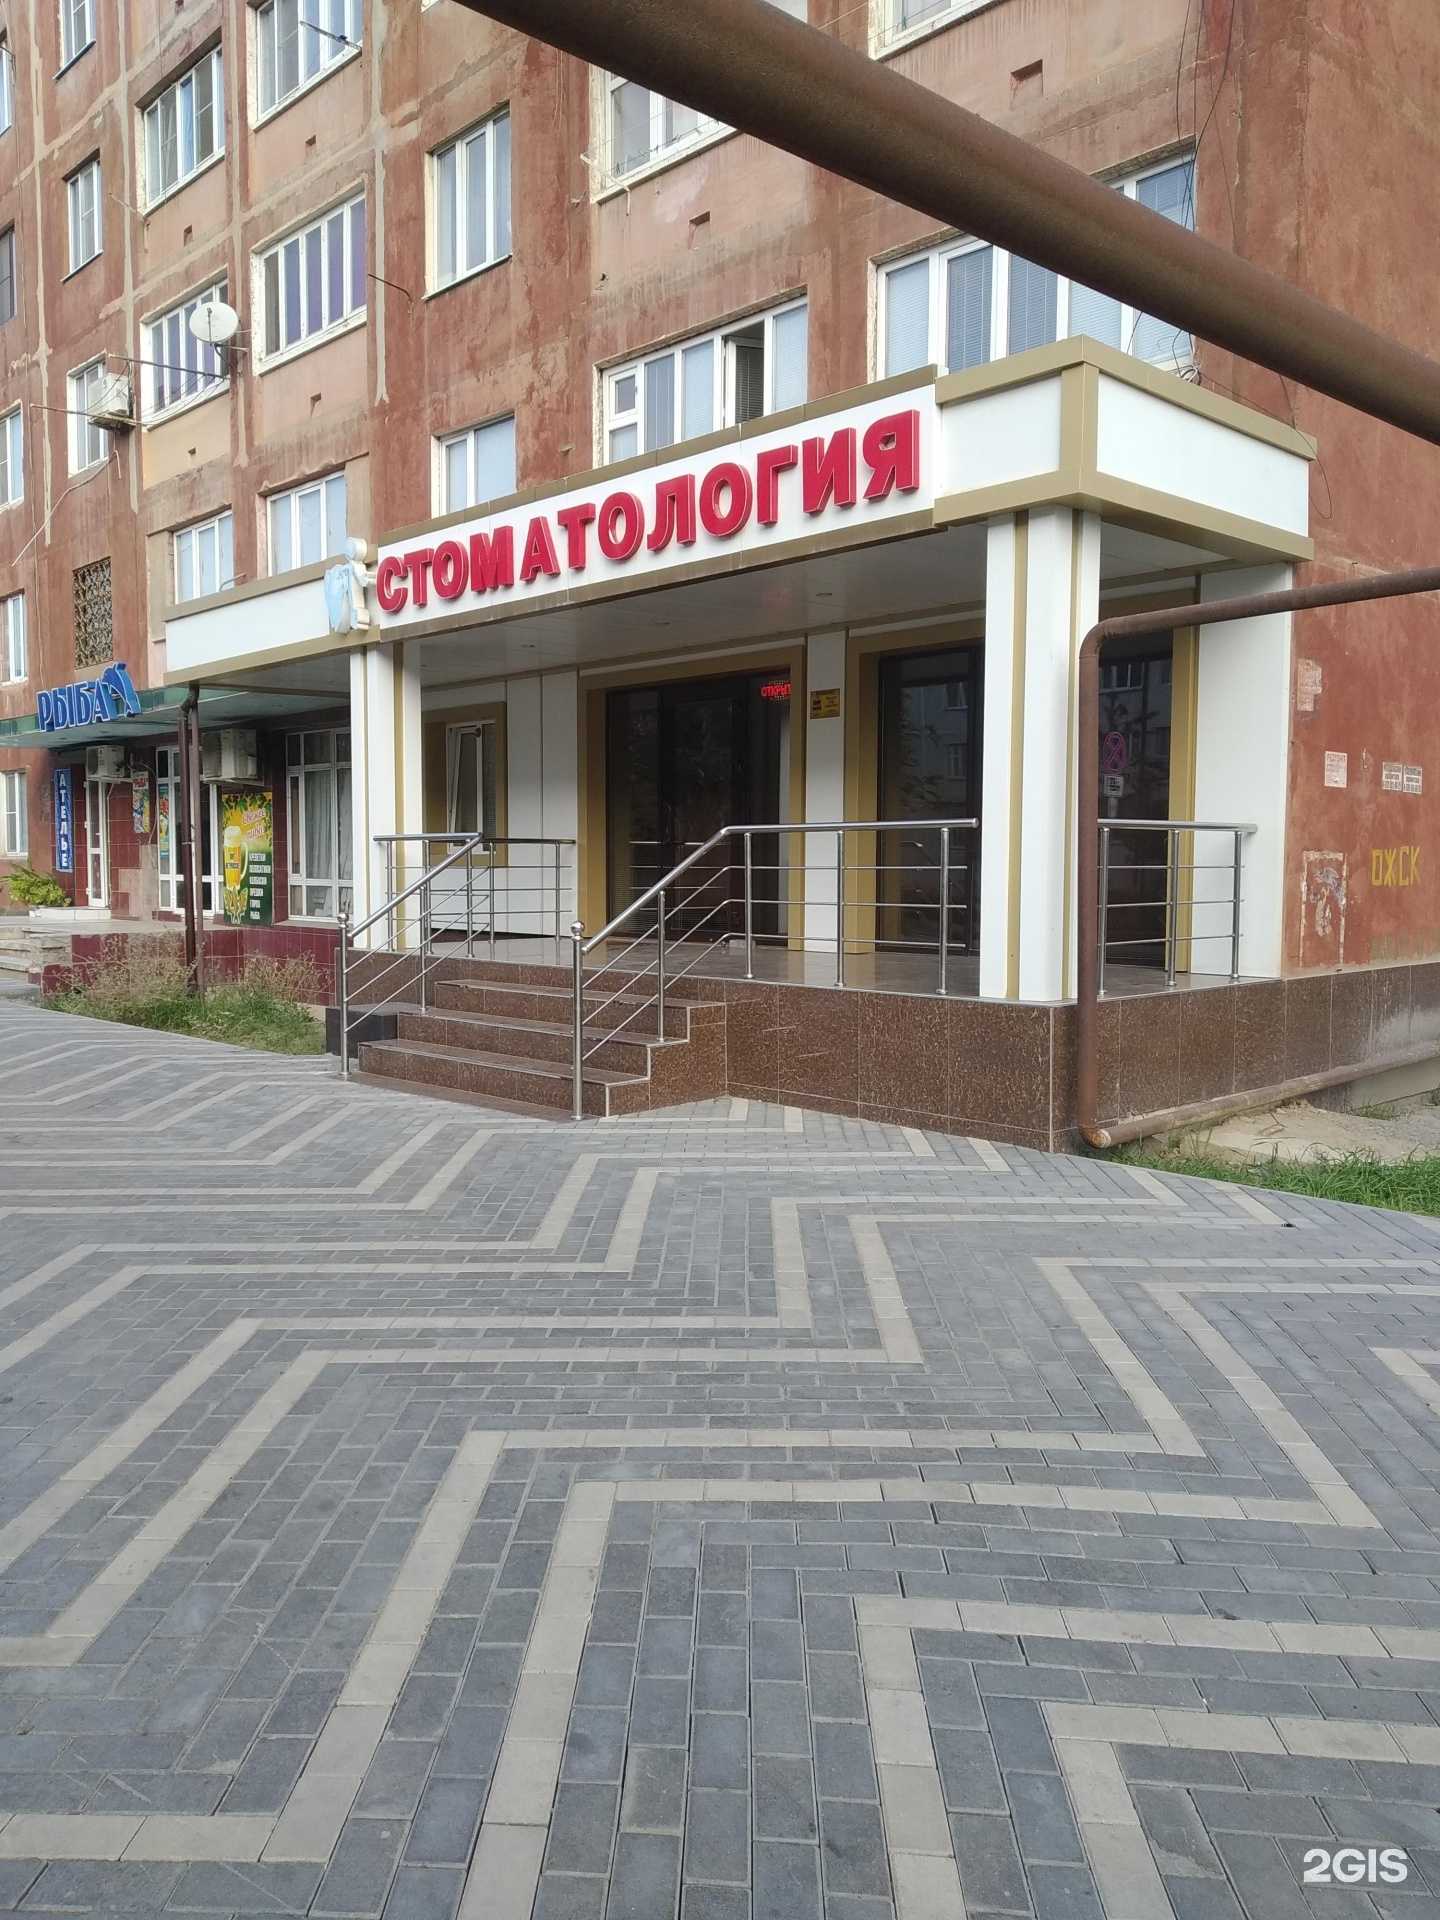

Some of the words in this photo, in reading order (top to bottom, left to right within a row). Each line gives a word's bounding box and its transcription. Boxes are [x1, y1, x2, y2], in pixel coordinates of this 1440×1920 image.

[376, 409, 921, 614] СТОМАТОЛОГИЯ
[37, 679, 118, 732] РЫБА
[59, 773, 69, 867] АТЕЛЬЕ
